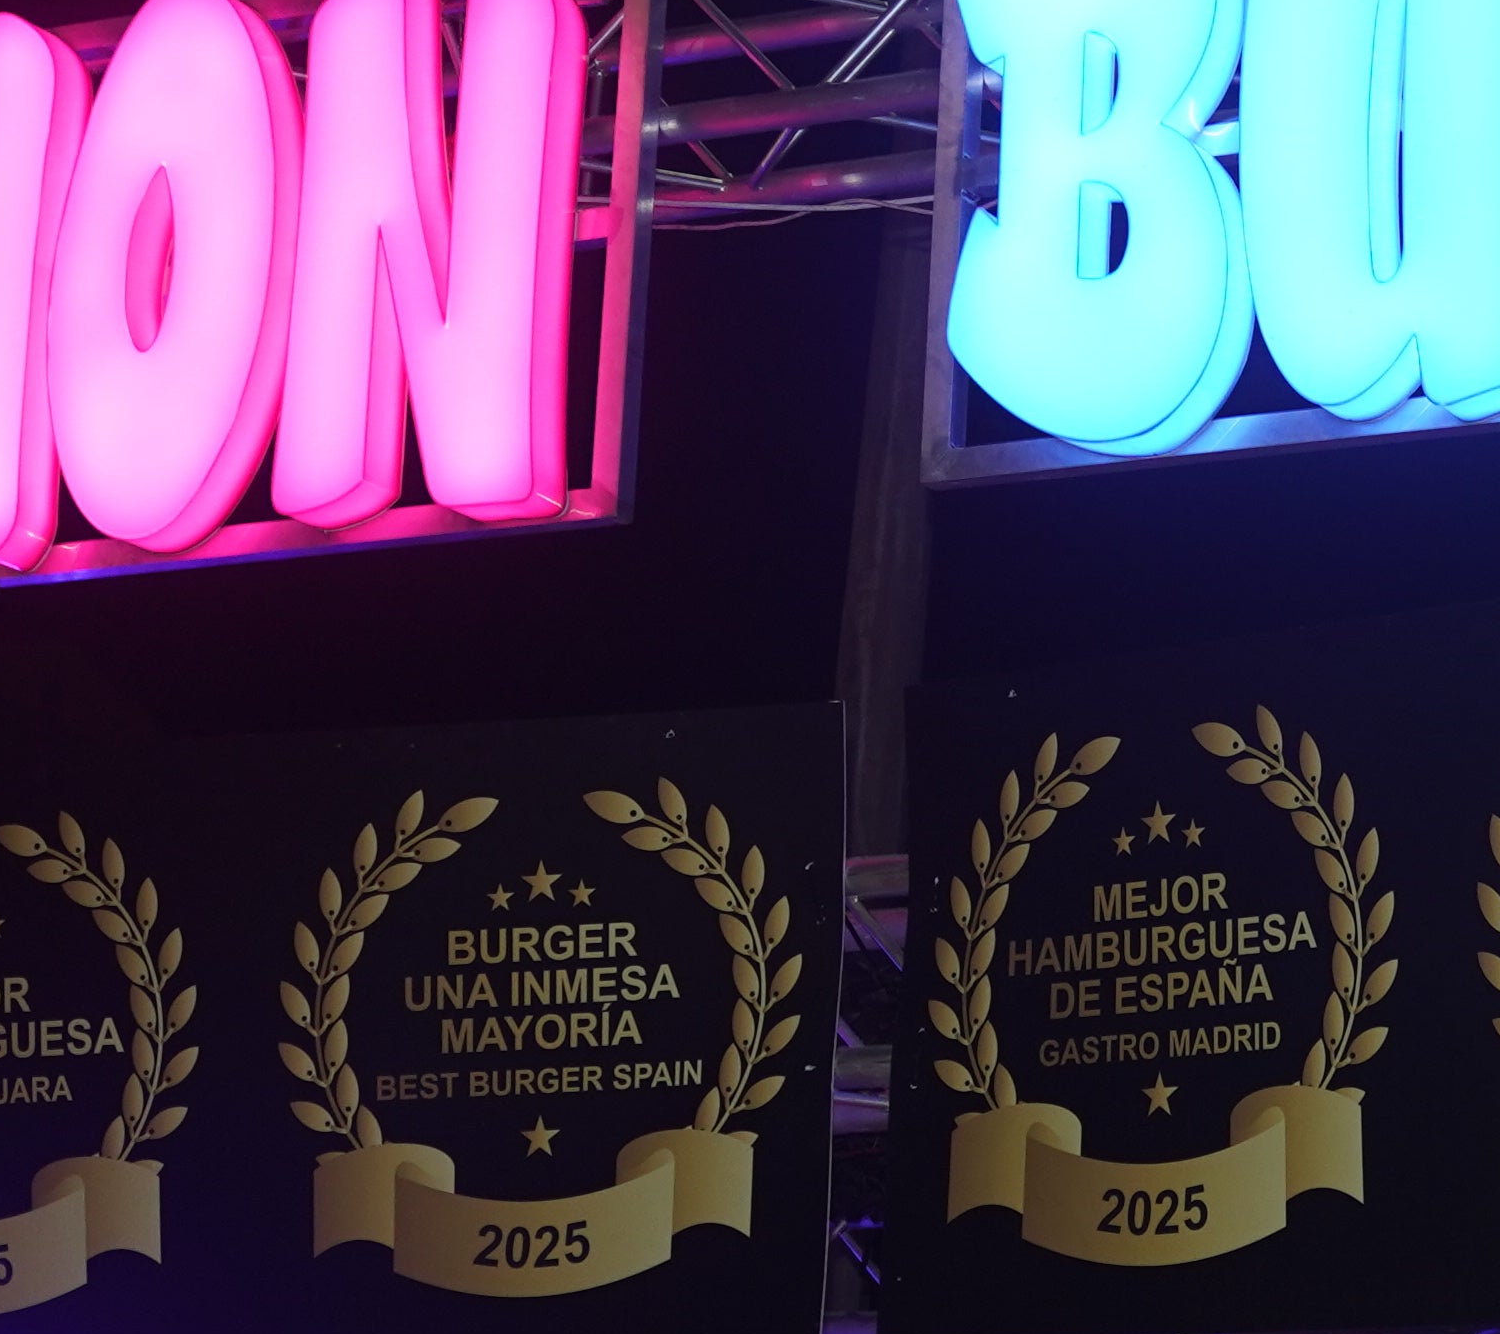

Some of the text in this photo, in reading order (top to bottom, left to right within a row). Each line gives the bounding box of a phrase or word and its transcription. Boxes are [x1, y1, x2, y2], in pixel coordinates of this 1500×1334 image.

[1093, 871, 1229, 923] MEJOR
[447, 922, 638, 966] BURGER
[1007, 911, 1317, 976] HAMBURGUESA
[403, 964, 681, 1012] UNA INMESA
[1049, 958, 1273, 1019] DE ESPAÑA
[440, 1003, 643, 1054] MAYORÍA
[1039, 1021, 1281, 1067] GASTRO MADRID
[376, 1060, 702, 1101] BEST BURGER SPAIN
[1097, 1183, 1209, 1236] 2025
[473, 1220, 591, 1269] 2025
